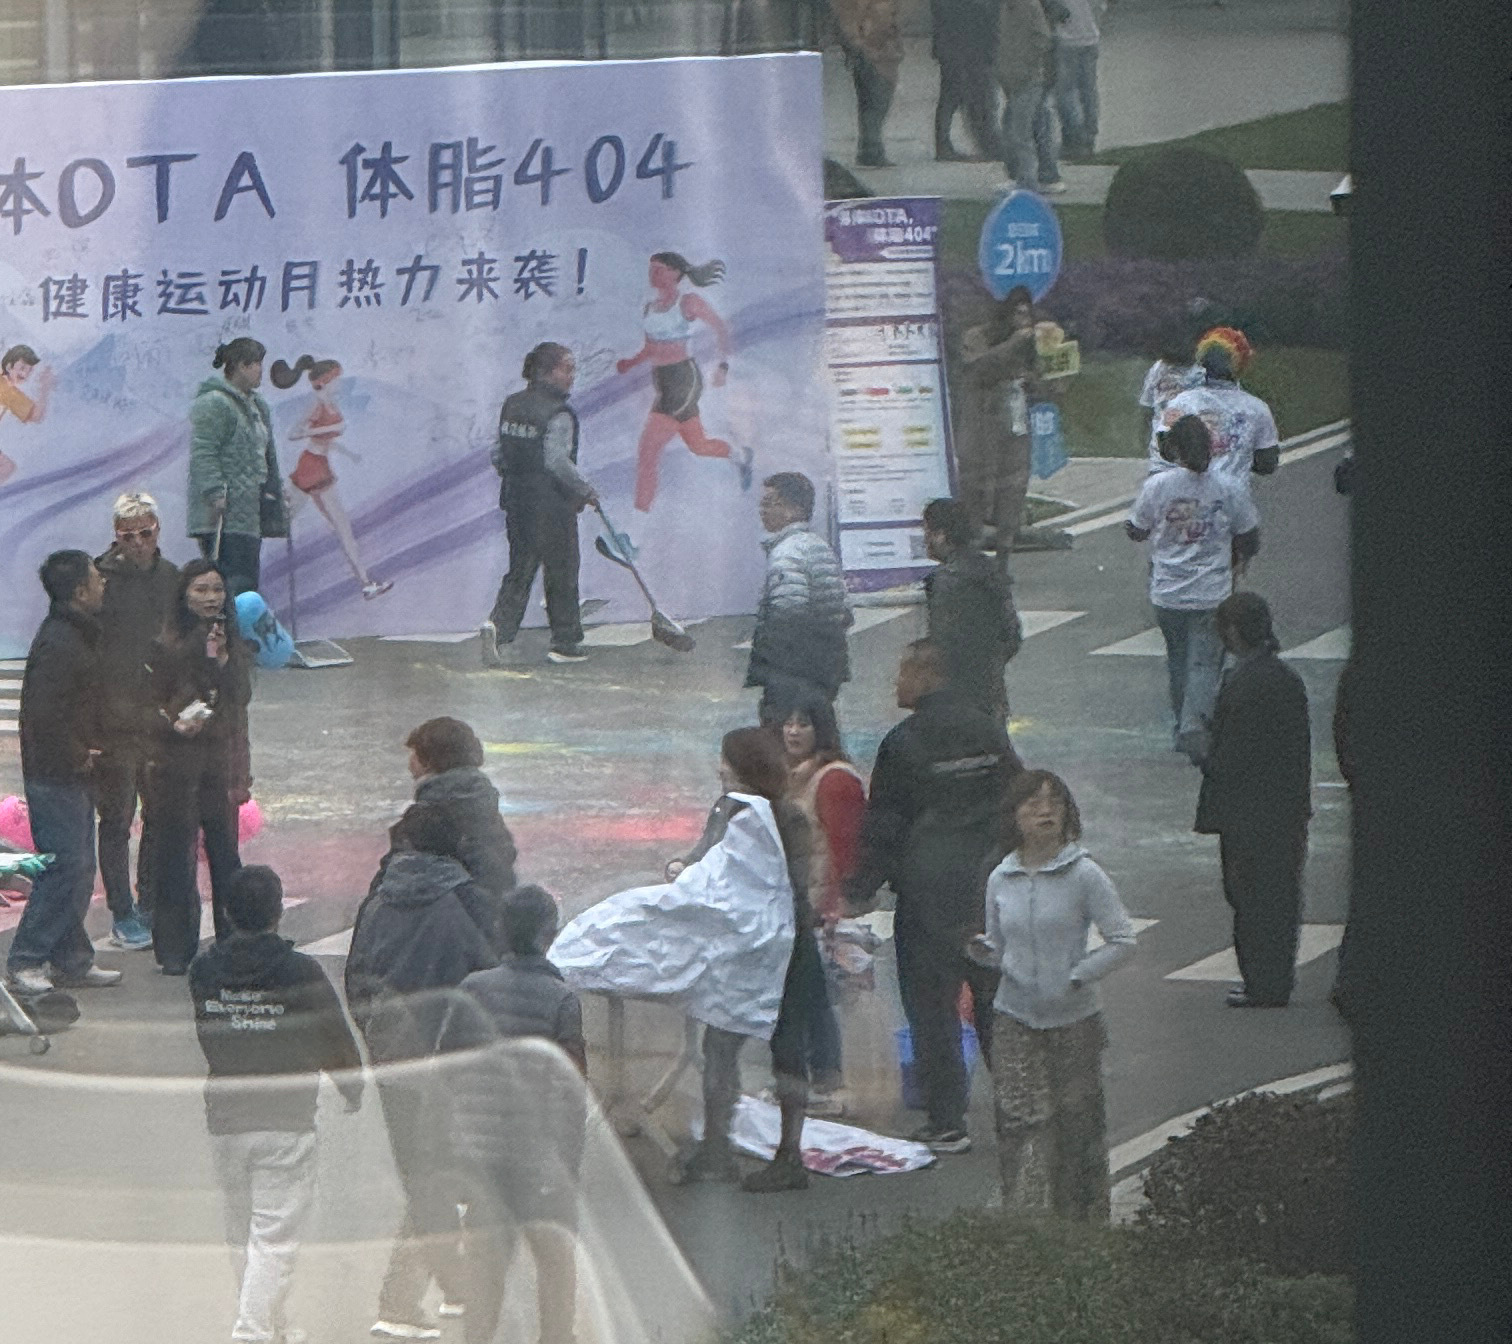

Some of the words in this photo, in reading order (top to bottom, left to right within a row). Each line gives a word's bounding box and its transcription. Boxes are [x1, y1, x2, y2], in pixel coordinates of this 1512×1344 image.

[339, 132, 695, 219] 体脂404
[38, 247, 589, 323] 健康运动月热力来袭！
